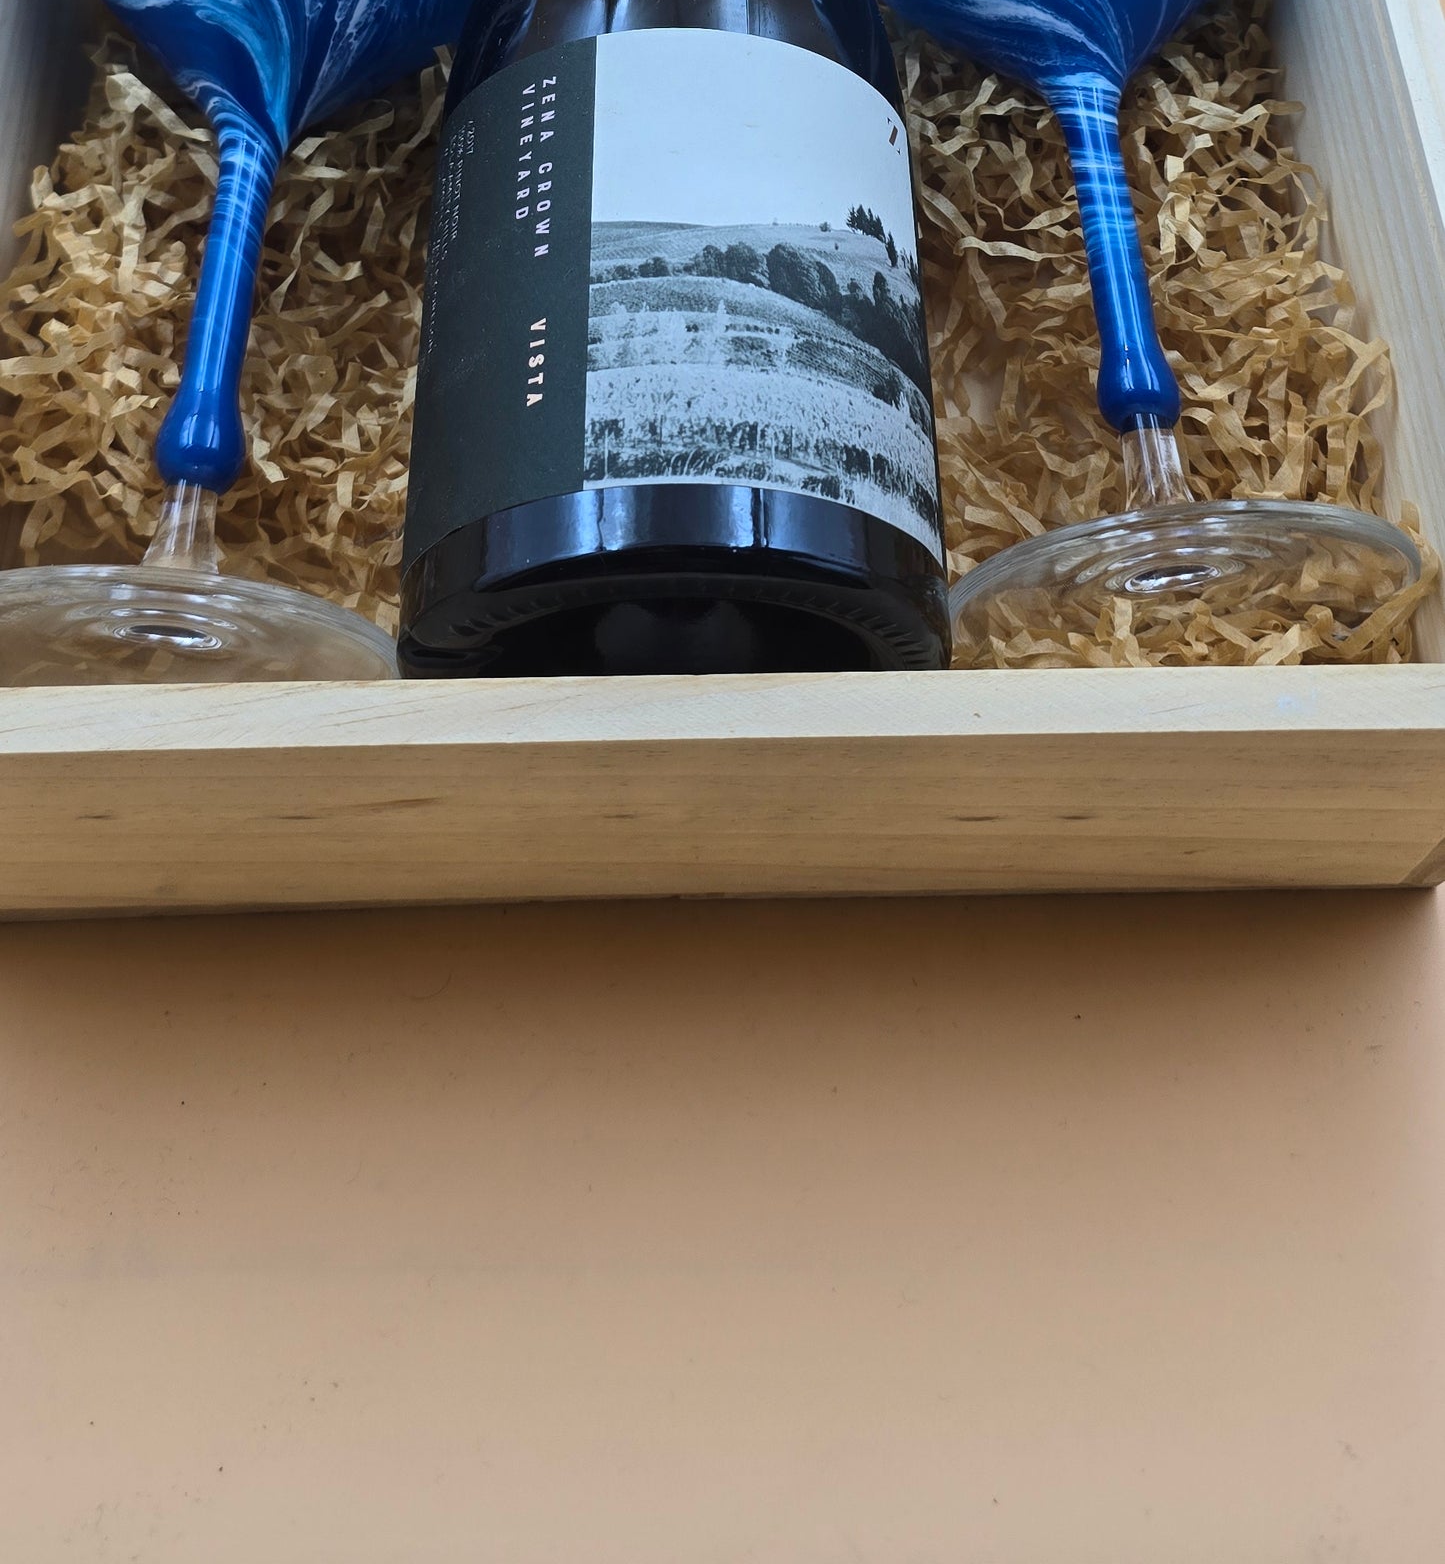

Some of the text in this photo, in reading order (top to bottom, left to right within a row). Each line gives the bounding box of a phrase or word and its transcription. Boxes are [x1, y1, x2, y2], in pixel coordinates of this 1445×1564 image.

[465, 127, 475, 155] 2017
[514, 83, 536, 221] VINEYARD
[533, 76, 557, 258] ZENA CROWN
[453, 159, 464, 201] PINOT
[449, 204, 461, 242] NOIR
[526, 317, 547, 408] VISTA
